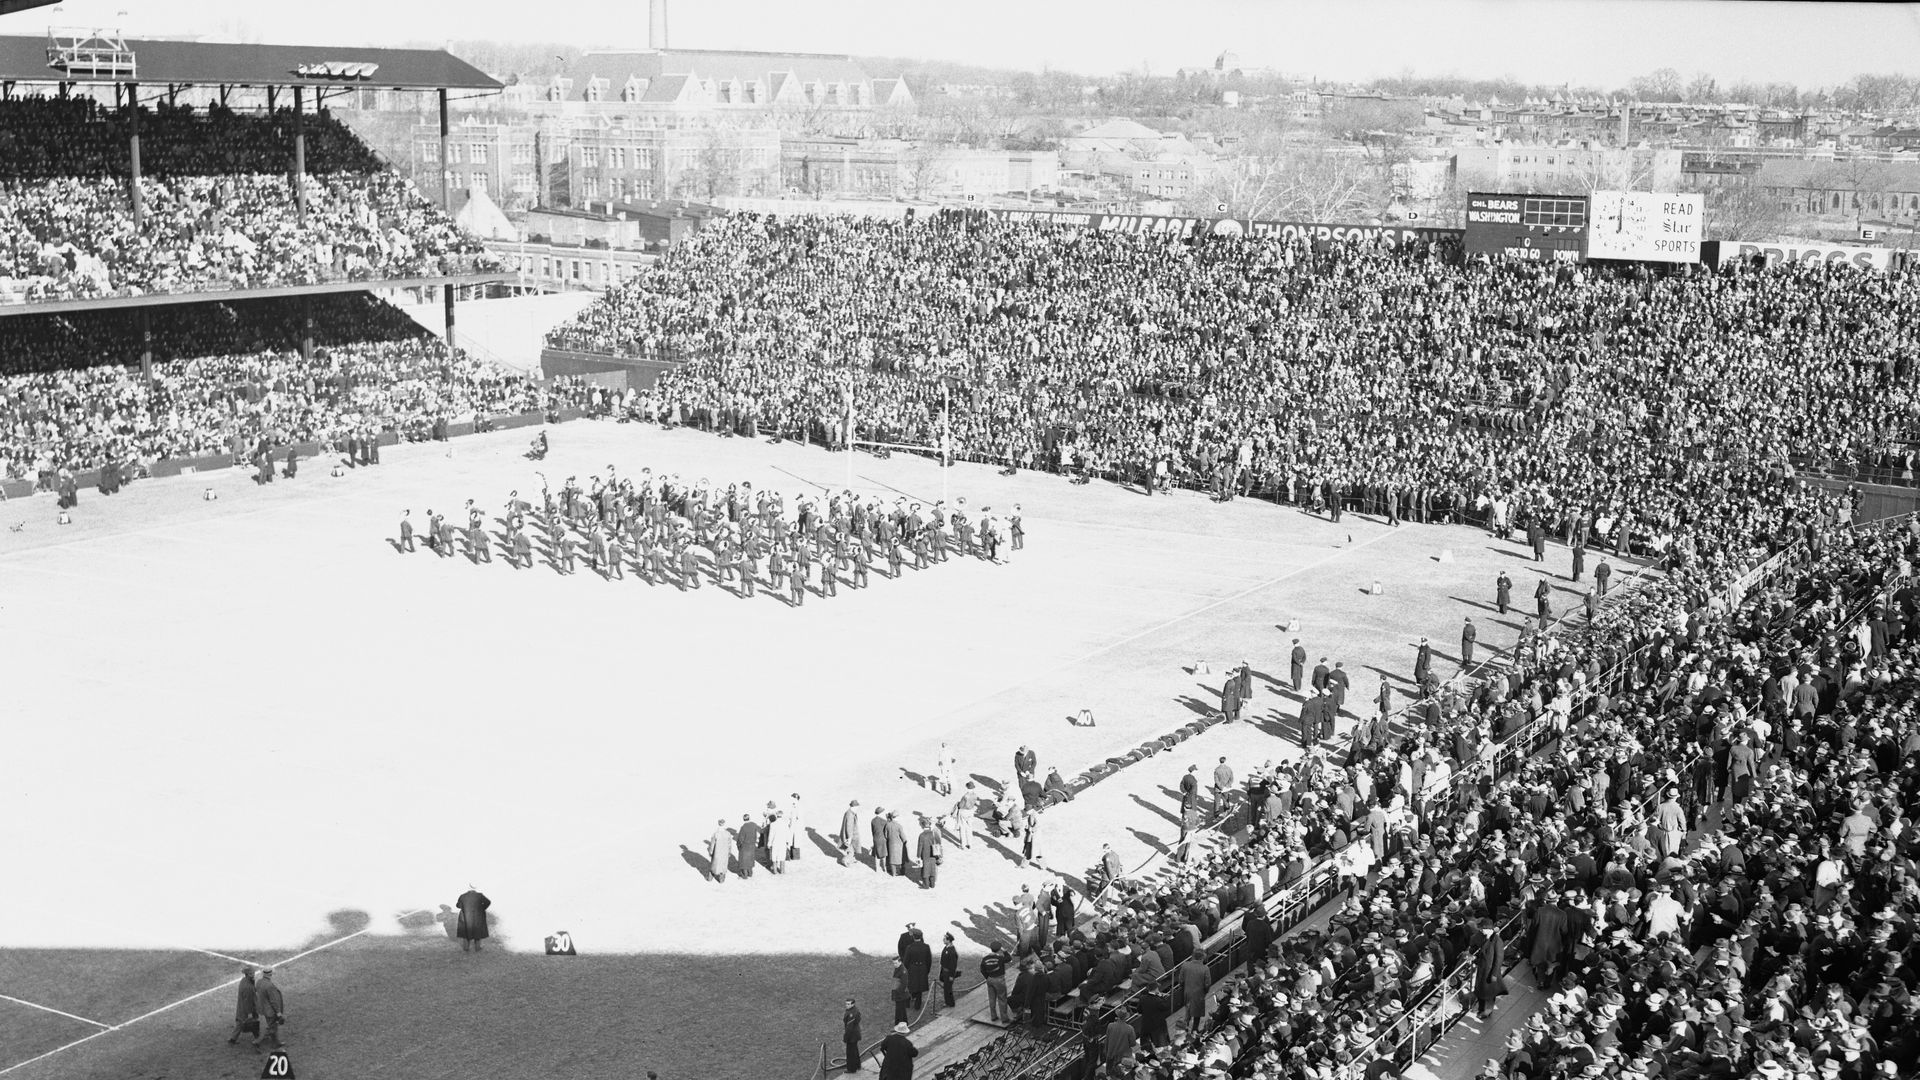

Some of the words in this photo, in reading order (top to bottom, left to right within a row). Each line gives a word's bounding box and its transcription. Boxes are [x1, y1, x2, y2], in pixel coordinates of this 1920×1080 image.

[1217, 204, 1226, 212] C
[1488, 199, 1519, 211] BEARS
[1663, 202, 1693, 216] READ
[1052, 213, 1091, 225] GASOLINES
[1408, 212, 1418, 220] D
[1468, 211, 1520, 224] WASHINGTON
[1255, 223, 1396, 250] THOMPSON'S
[1862, 230, 1873, 239] E
[1654, 239, 1696, 253] SPORTS
[1520, 247, 1528, 259] TO
[1529, 248, 1540, 260] GO
[1553, 249, 1579, 262] DOWN
[1739, 244, 1874, 269] BRIGGS
[552, 933, 570, 952] 30
[269, 1055, 288, 1076] 20
